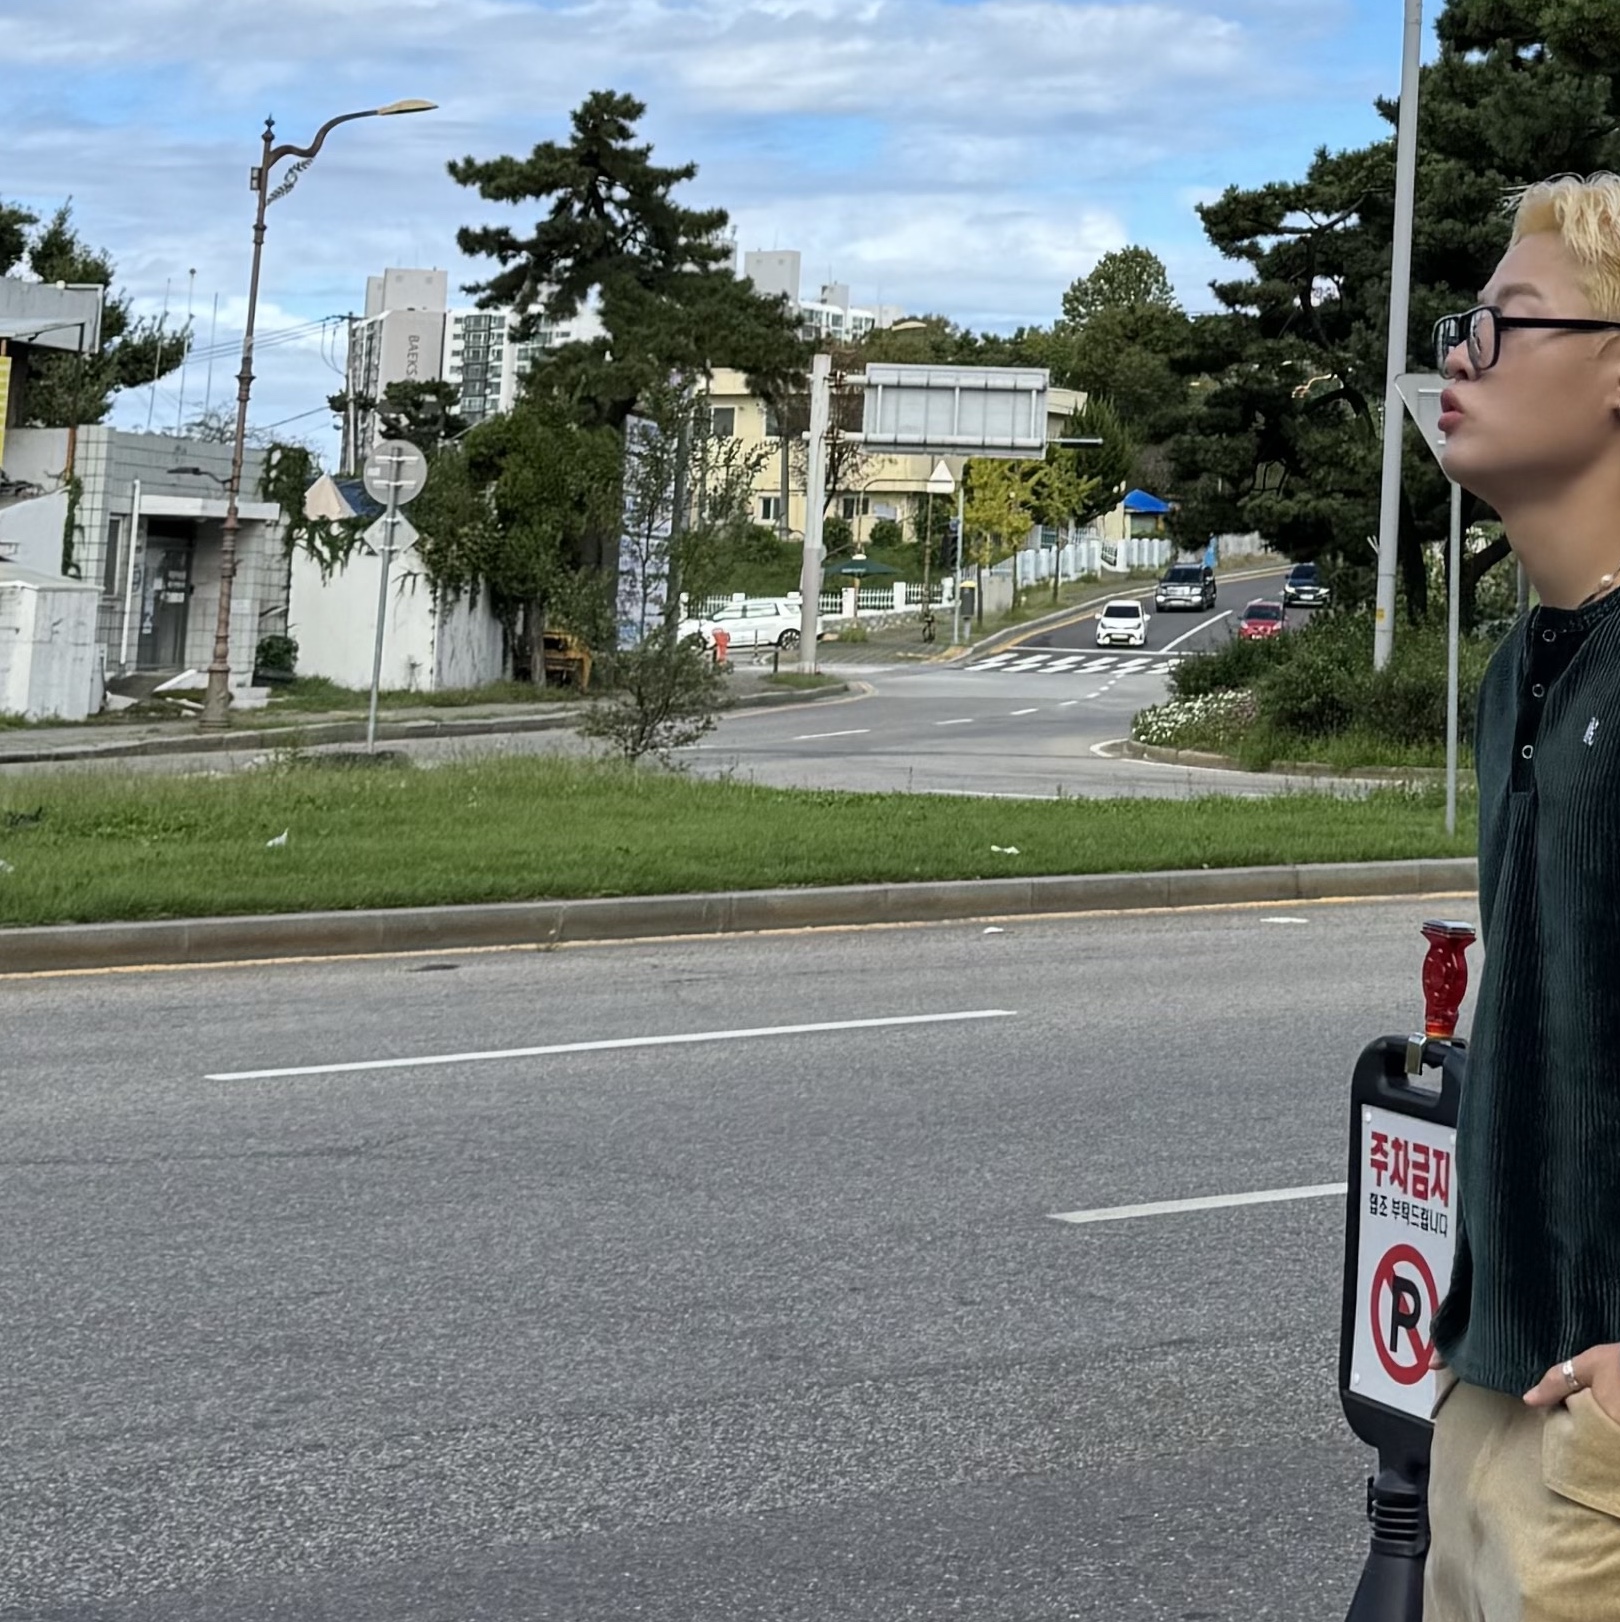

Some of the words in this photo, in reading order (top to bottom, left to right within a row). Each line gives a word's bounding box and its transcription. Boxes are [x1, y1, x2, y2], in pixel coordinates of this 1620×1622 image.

[406, 334, 420, 376] BAEKS
[1370, 1130, 1450, 1208] 주차금지
[1370, 1192, 1388, 1217] 협조
[1391, 1198, 1448, 1238] 부탁드립니다
[1389, 1274, 1422, 1353] P
